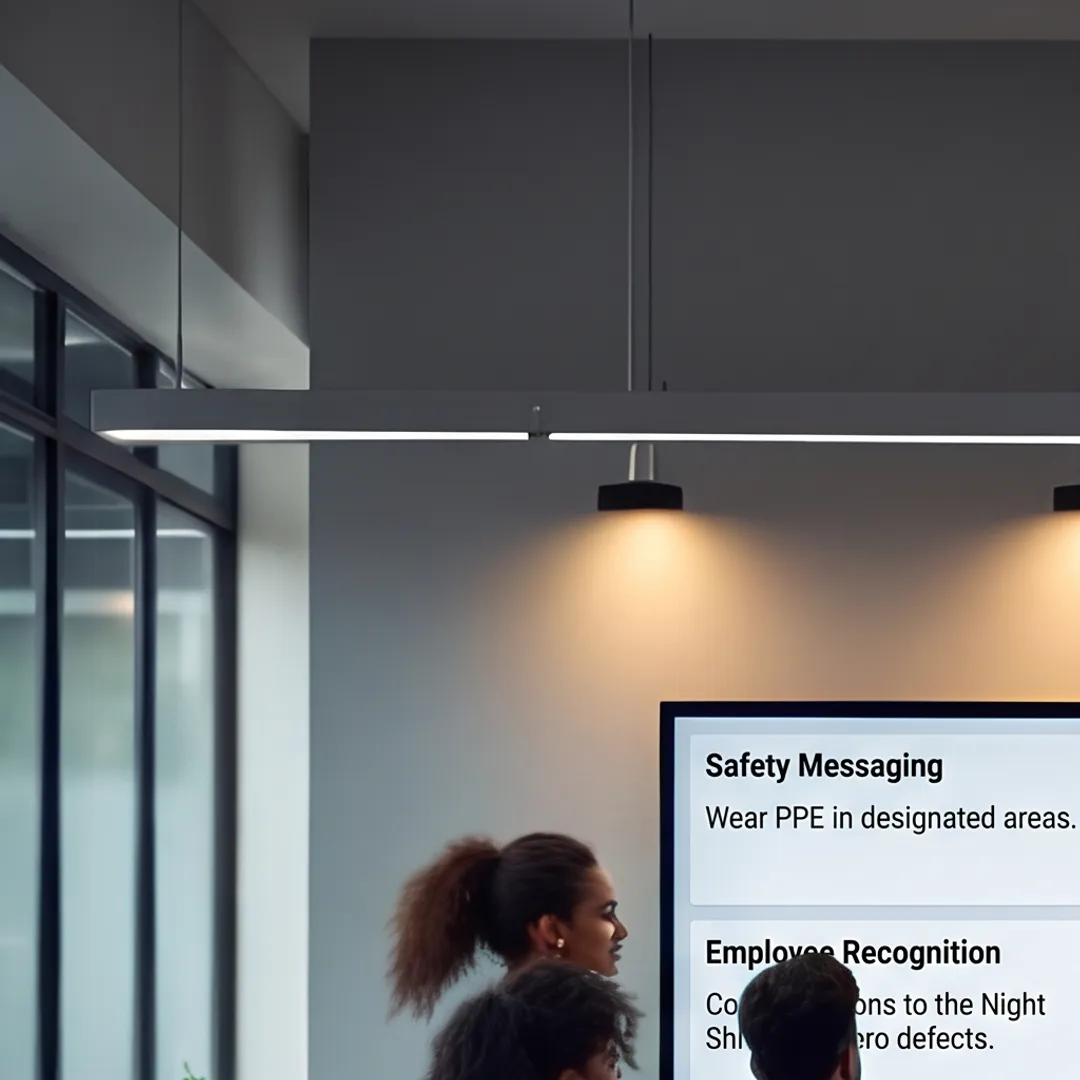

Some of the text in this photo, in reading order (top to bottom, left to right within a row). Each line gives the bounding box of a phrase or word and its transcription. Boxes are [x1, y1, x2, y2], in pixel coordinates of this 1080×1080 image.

[706, 752, 943, 783] Safety Messaging
[706, 805, 1076, 834] Wear PPE in designated areas.
[843, 939, 1001, 969] Recognition
[903, 994, 927, 1015] to
[935, 992, 973, 1015] the
[982, 992, 1046, 1021] Night
[857, 1032, 889, 1049] ero
[897, 1026, 994, 1049] defects.
